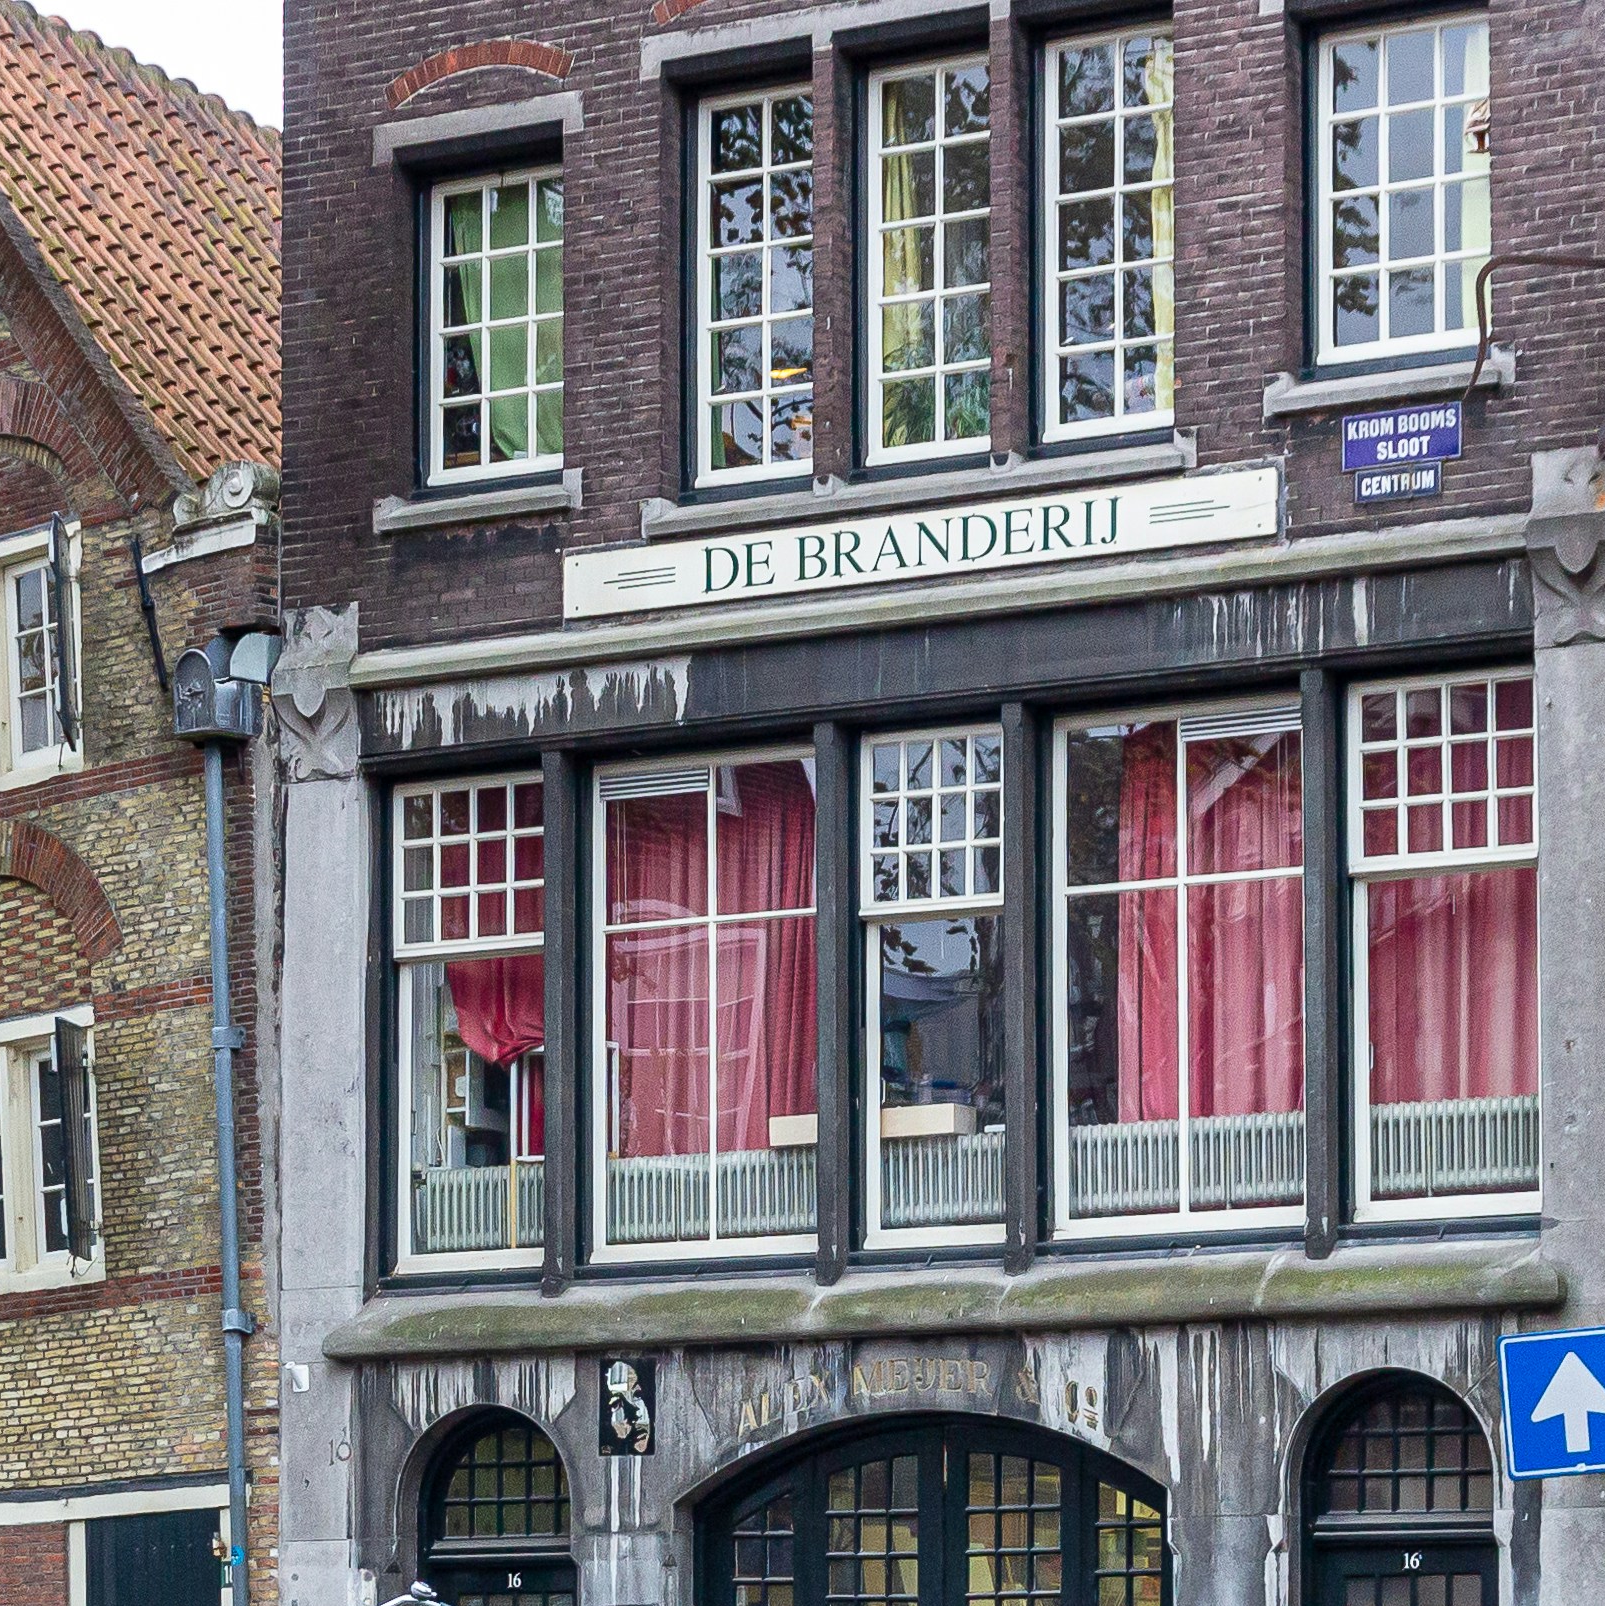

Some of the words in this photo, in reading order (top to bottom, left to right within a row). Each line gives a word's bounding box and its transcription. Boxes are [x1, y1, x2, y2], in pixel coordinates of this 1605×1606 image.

[1347, 416, 1394, 441] KROM
[1397, 408, 1457, 434] BOOMS
[1376, 435, 1431, 461] SLOOT
[1361, 469, 1435, 496] CENTRUM
[702, 540, 776, 595] DE
[794, 495, 1123, 582] BRANDERIJ
[506, 1571, 522, 1588] 16
